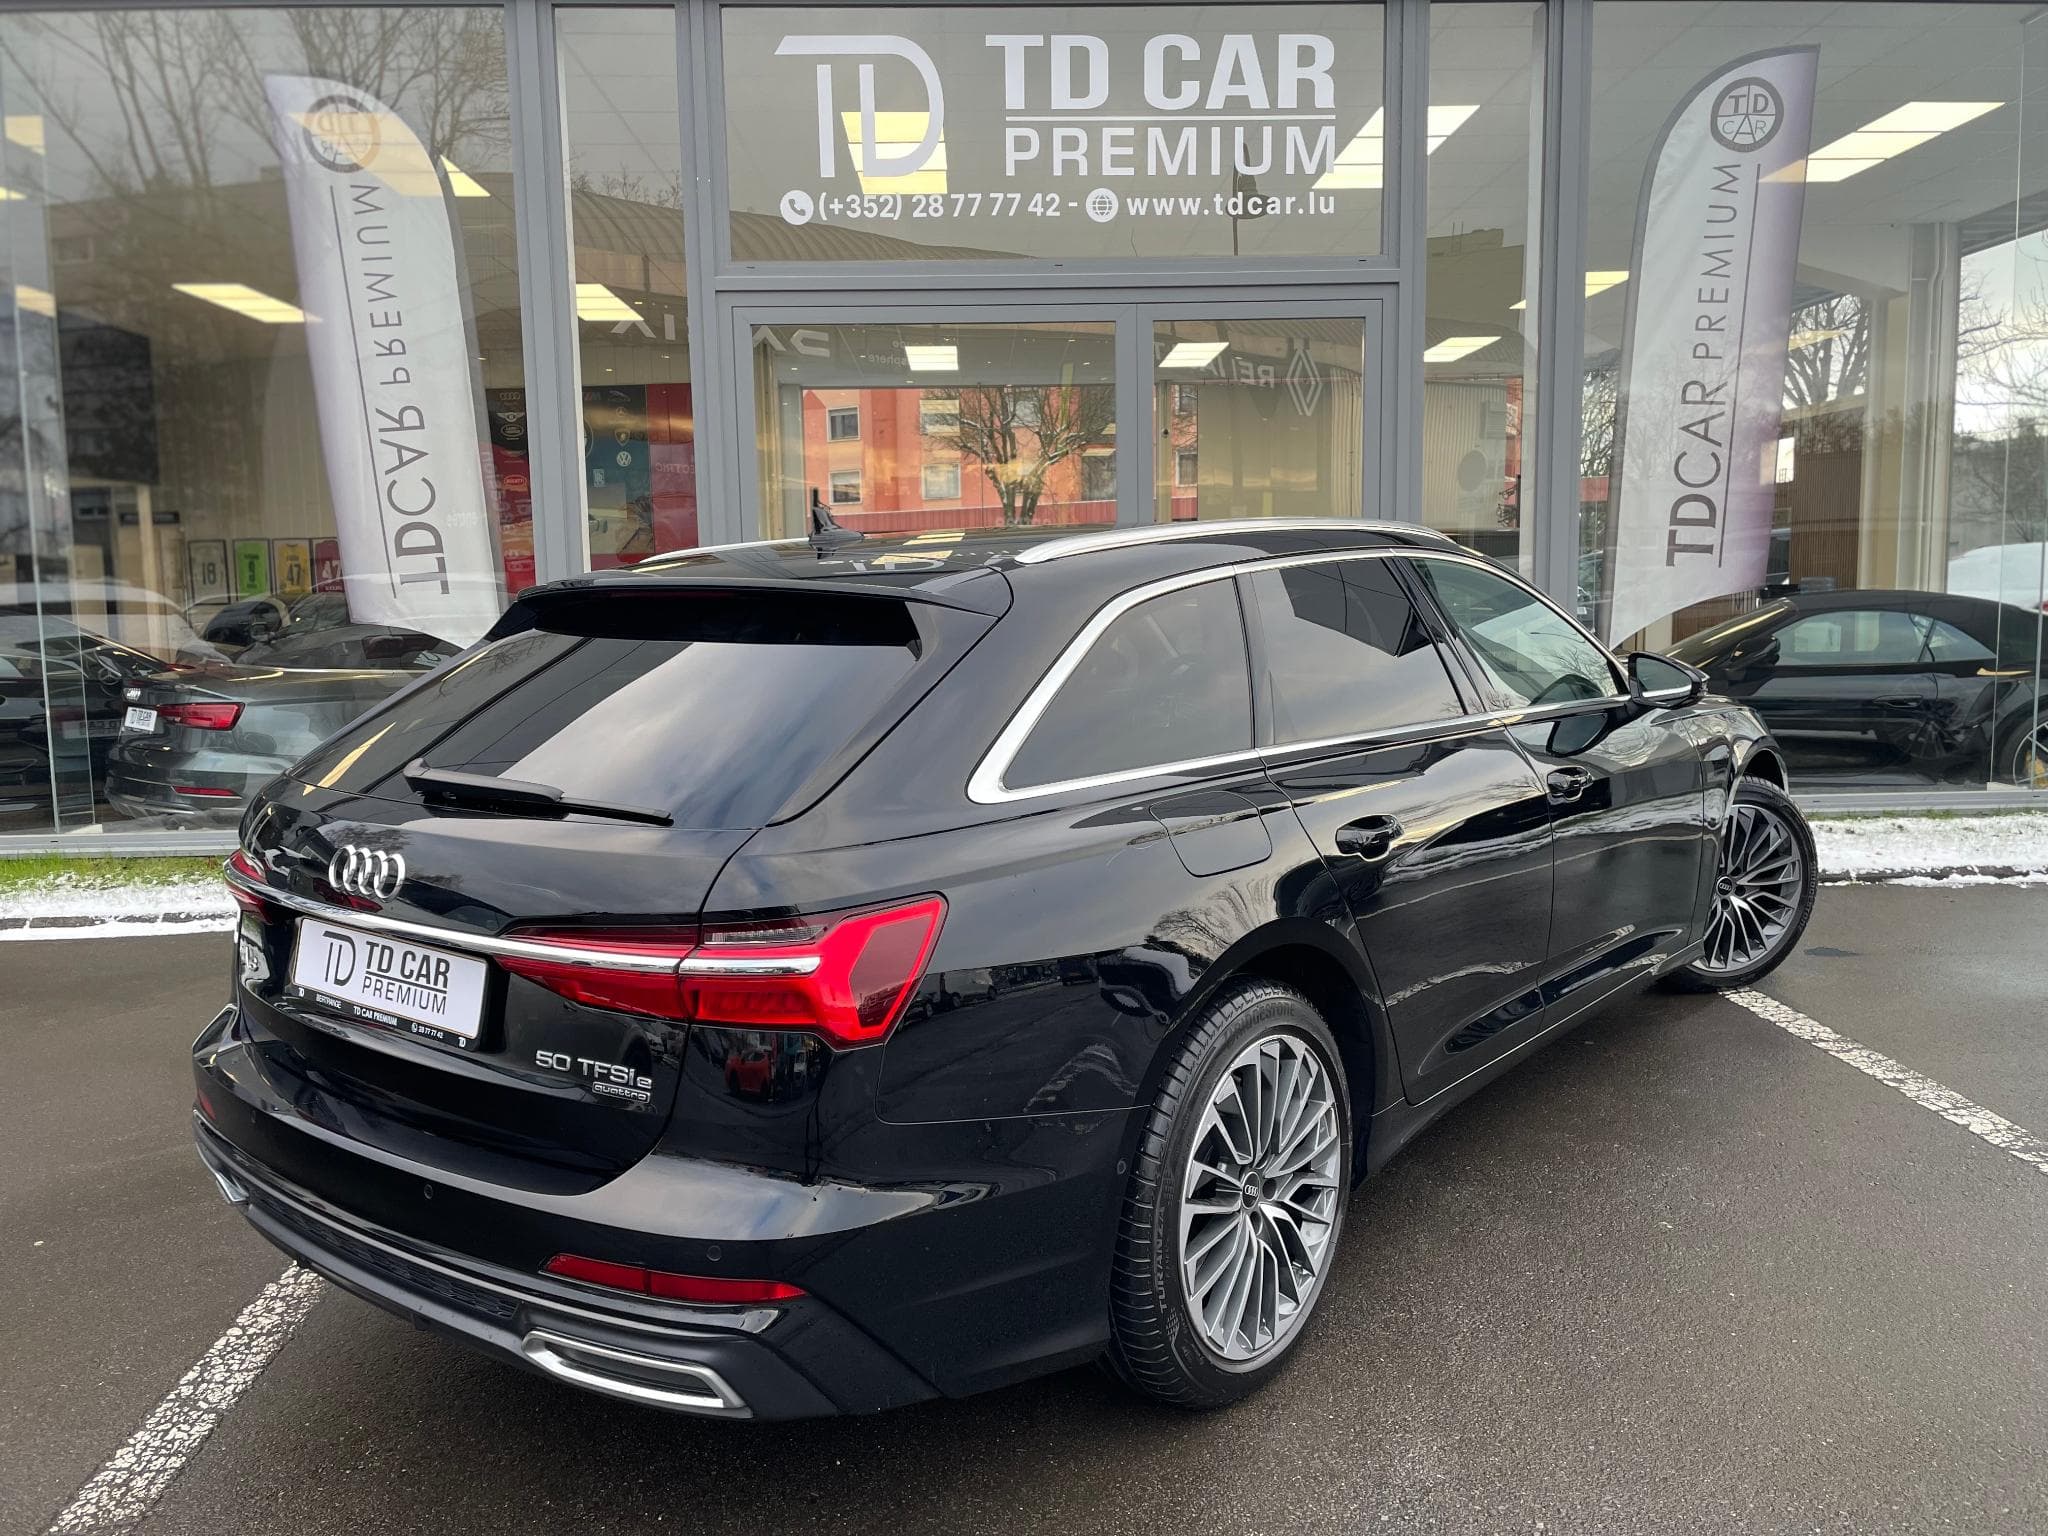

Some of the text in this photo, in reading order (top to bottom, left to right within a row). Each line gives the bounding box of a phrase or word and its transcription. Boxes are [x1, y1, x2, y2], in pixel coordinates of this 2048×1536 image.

[985, 33, 1336, 110] TD CAR
[1728, 93, 1769, 114] TD
[1722, 114, 1767, 143] CAR
[1005, 126, 1336, 177] PREMIUM
[818, 192, 902, 220] (+352)
[911, 194, 945, 218] 28
[950, 193, 982, 217] 77
[989, 193, 1021, 217] 77
[1027, 193, 1061, 217] 42
[1126, 191, 1335, 216] www.tdcar.lu
[1691, 163, 1742, 360] PREMIUM
[202, 562, 216, 585] 18
[286, 563, 302, 586] 47
[365, 941, 451, 989] TD CAR
[362, 976, 447, 1015] PREMIUM
[361, 1007, 373, 1019] CAR
[535, 1049, 571, 1072] 50
[594, 1083, 648, 1100] quattro
